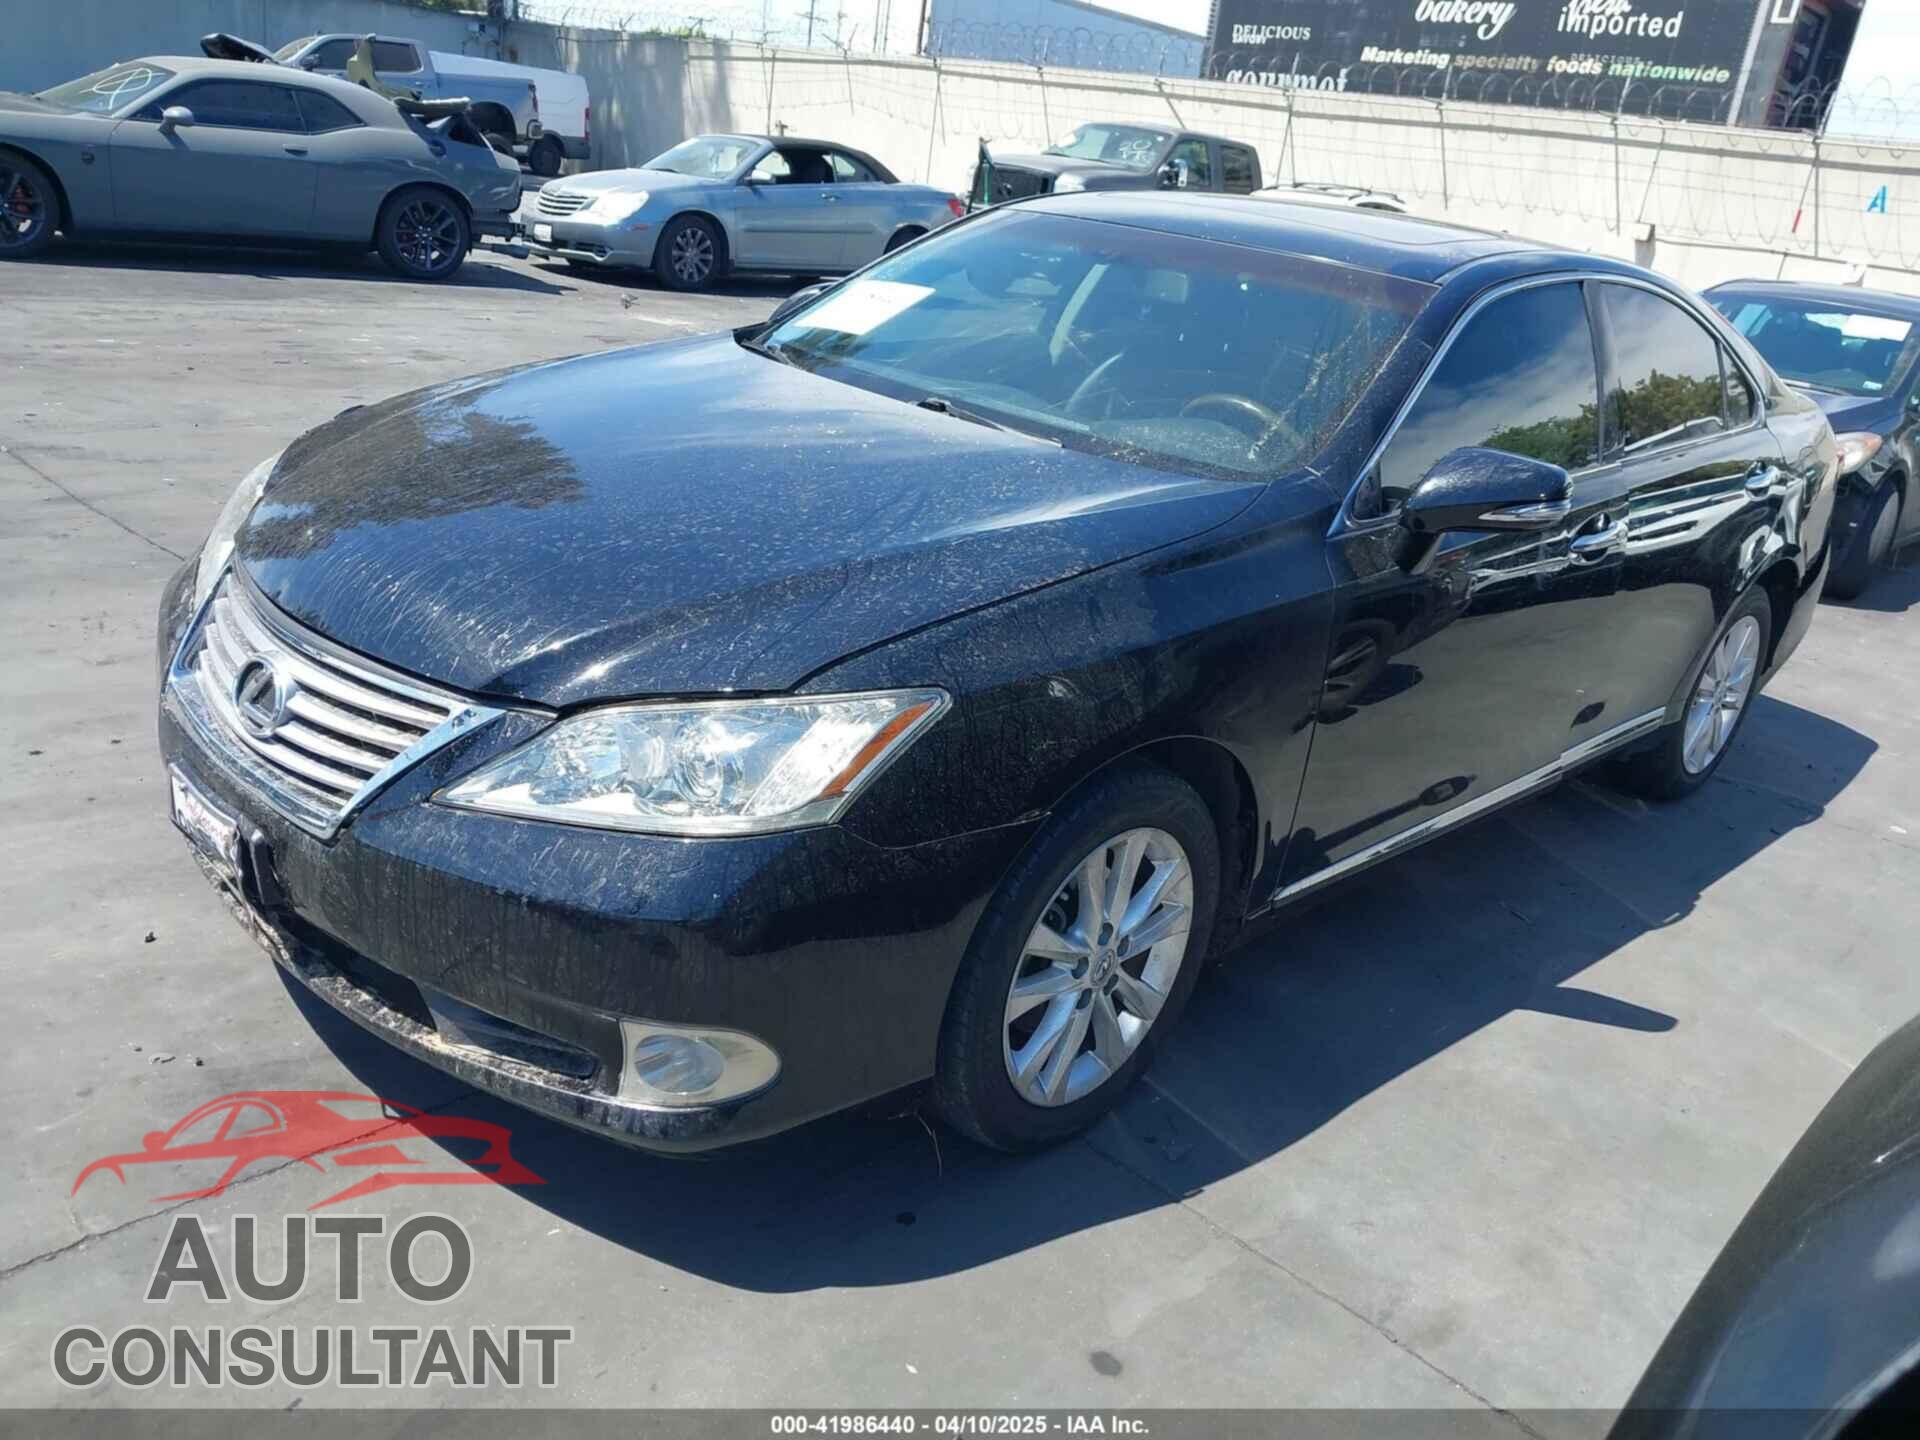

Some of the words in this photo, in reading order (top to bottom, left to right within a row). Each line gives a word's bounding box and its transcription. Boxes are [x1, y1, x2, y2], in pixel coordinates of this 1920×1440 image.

[1231, 24, 1311, 40] DELICIOUS
[1415, 0, 1517, 40] bakery
[1557, 6, 1684, 39] imported
[1360, 46, 1451, 69] Marketing
[1454, 53, 1539, 72] specialty
[1546, 55, 1604, 75] foods
[1608, 60, 1730, 83] nationwide
